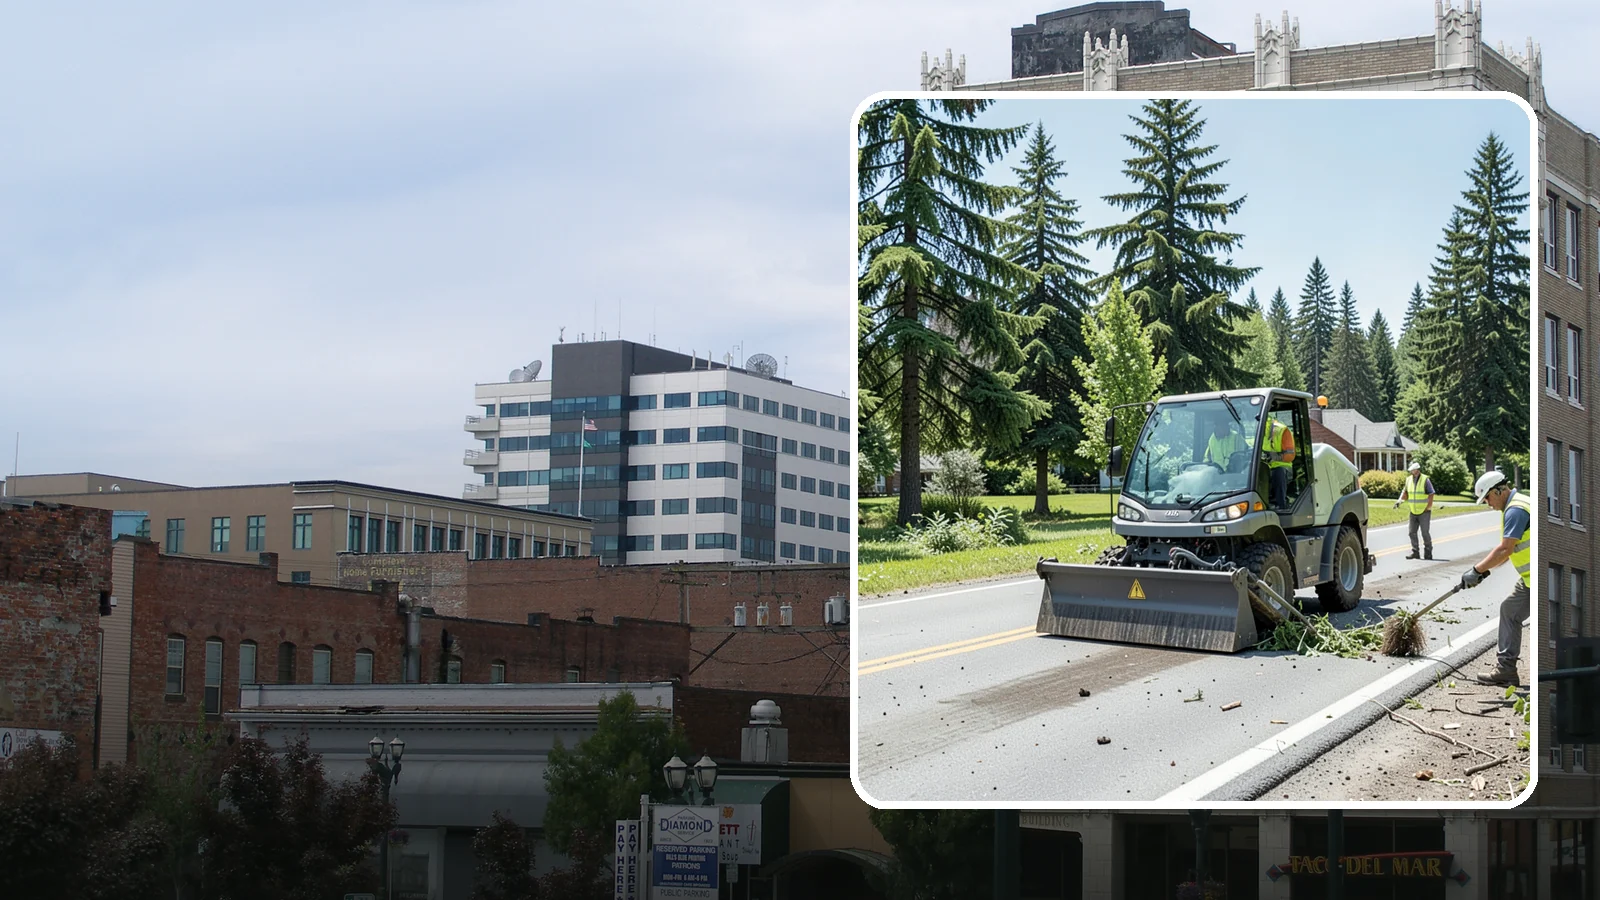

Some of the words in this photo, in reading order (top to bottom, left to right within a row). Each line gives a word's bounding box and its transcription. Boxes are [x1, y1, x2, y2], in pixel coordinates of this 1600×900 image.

[343, 568, 368, 577] Home
[370, 566, 427, 577] Furnishers
[660, 818, 713, 833] DIAMOND
[1021, 815, 1070, 827] BUILDING
[617, 824, 625, 852] PAY
[628, 824, 637, 852] PAY
[656, 845, 688, 853] RESERVED
[689, 846, 716, 854] PARKING
[722, 852, 739, 862] Soup
[671, 862, 701, 870] PATRONS
[1346, 856, 1385, 876] DEL
[1392, 857, 1442, 877] MAR
[616, 856, 625, 893] HERE
[627, 856, 636, 893] HERE
[660, 889, 682, 897] PUBLIC
[683, 889, 710, 898] PARKING
